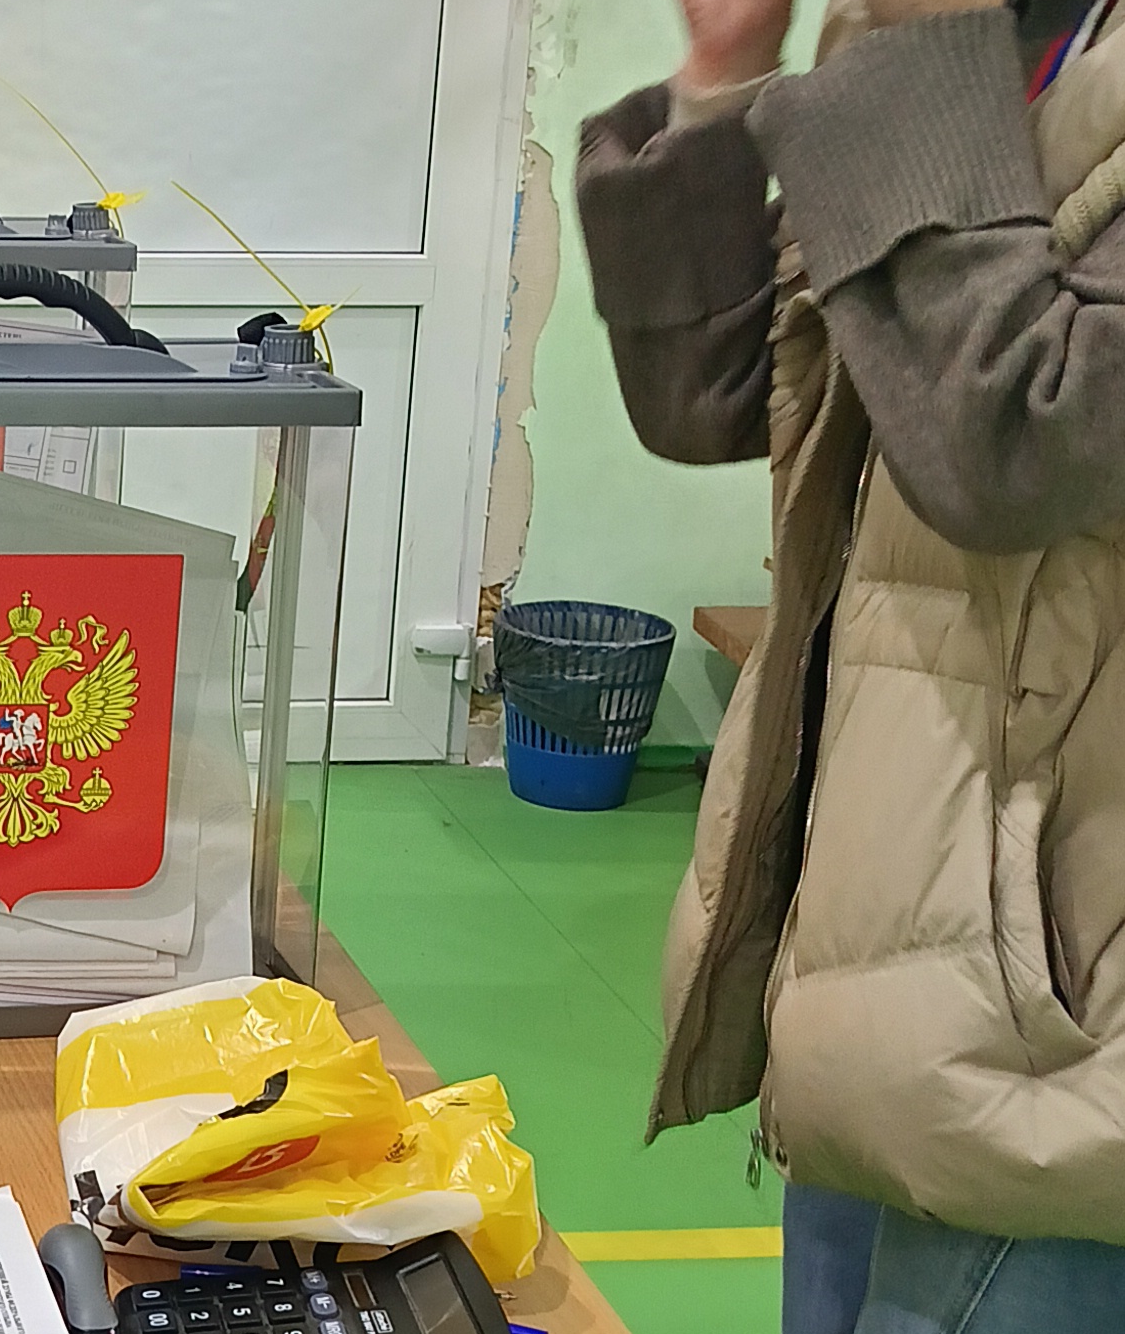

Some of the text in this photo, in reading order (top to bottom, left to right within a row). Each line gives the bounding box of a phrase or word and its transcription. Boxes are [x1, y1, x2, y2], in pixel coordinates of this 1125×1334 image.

[226, 1282, 244, 1290] 4
[266, 1278, 284, 1288] 7
[142, 1290, 161, 1299] 0
[274, 1303, 293, 1312] 8
[190, 1312, 209, 1321] 2
[233, 1308, 252, 1317] 5
[148, 1313, 169, 1327] 00
